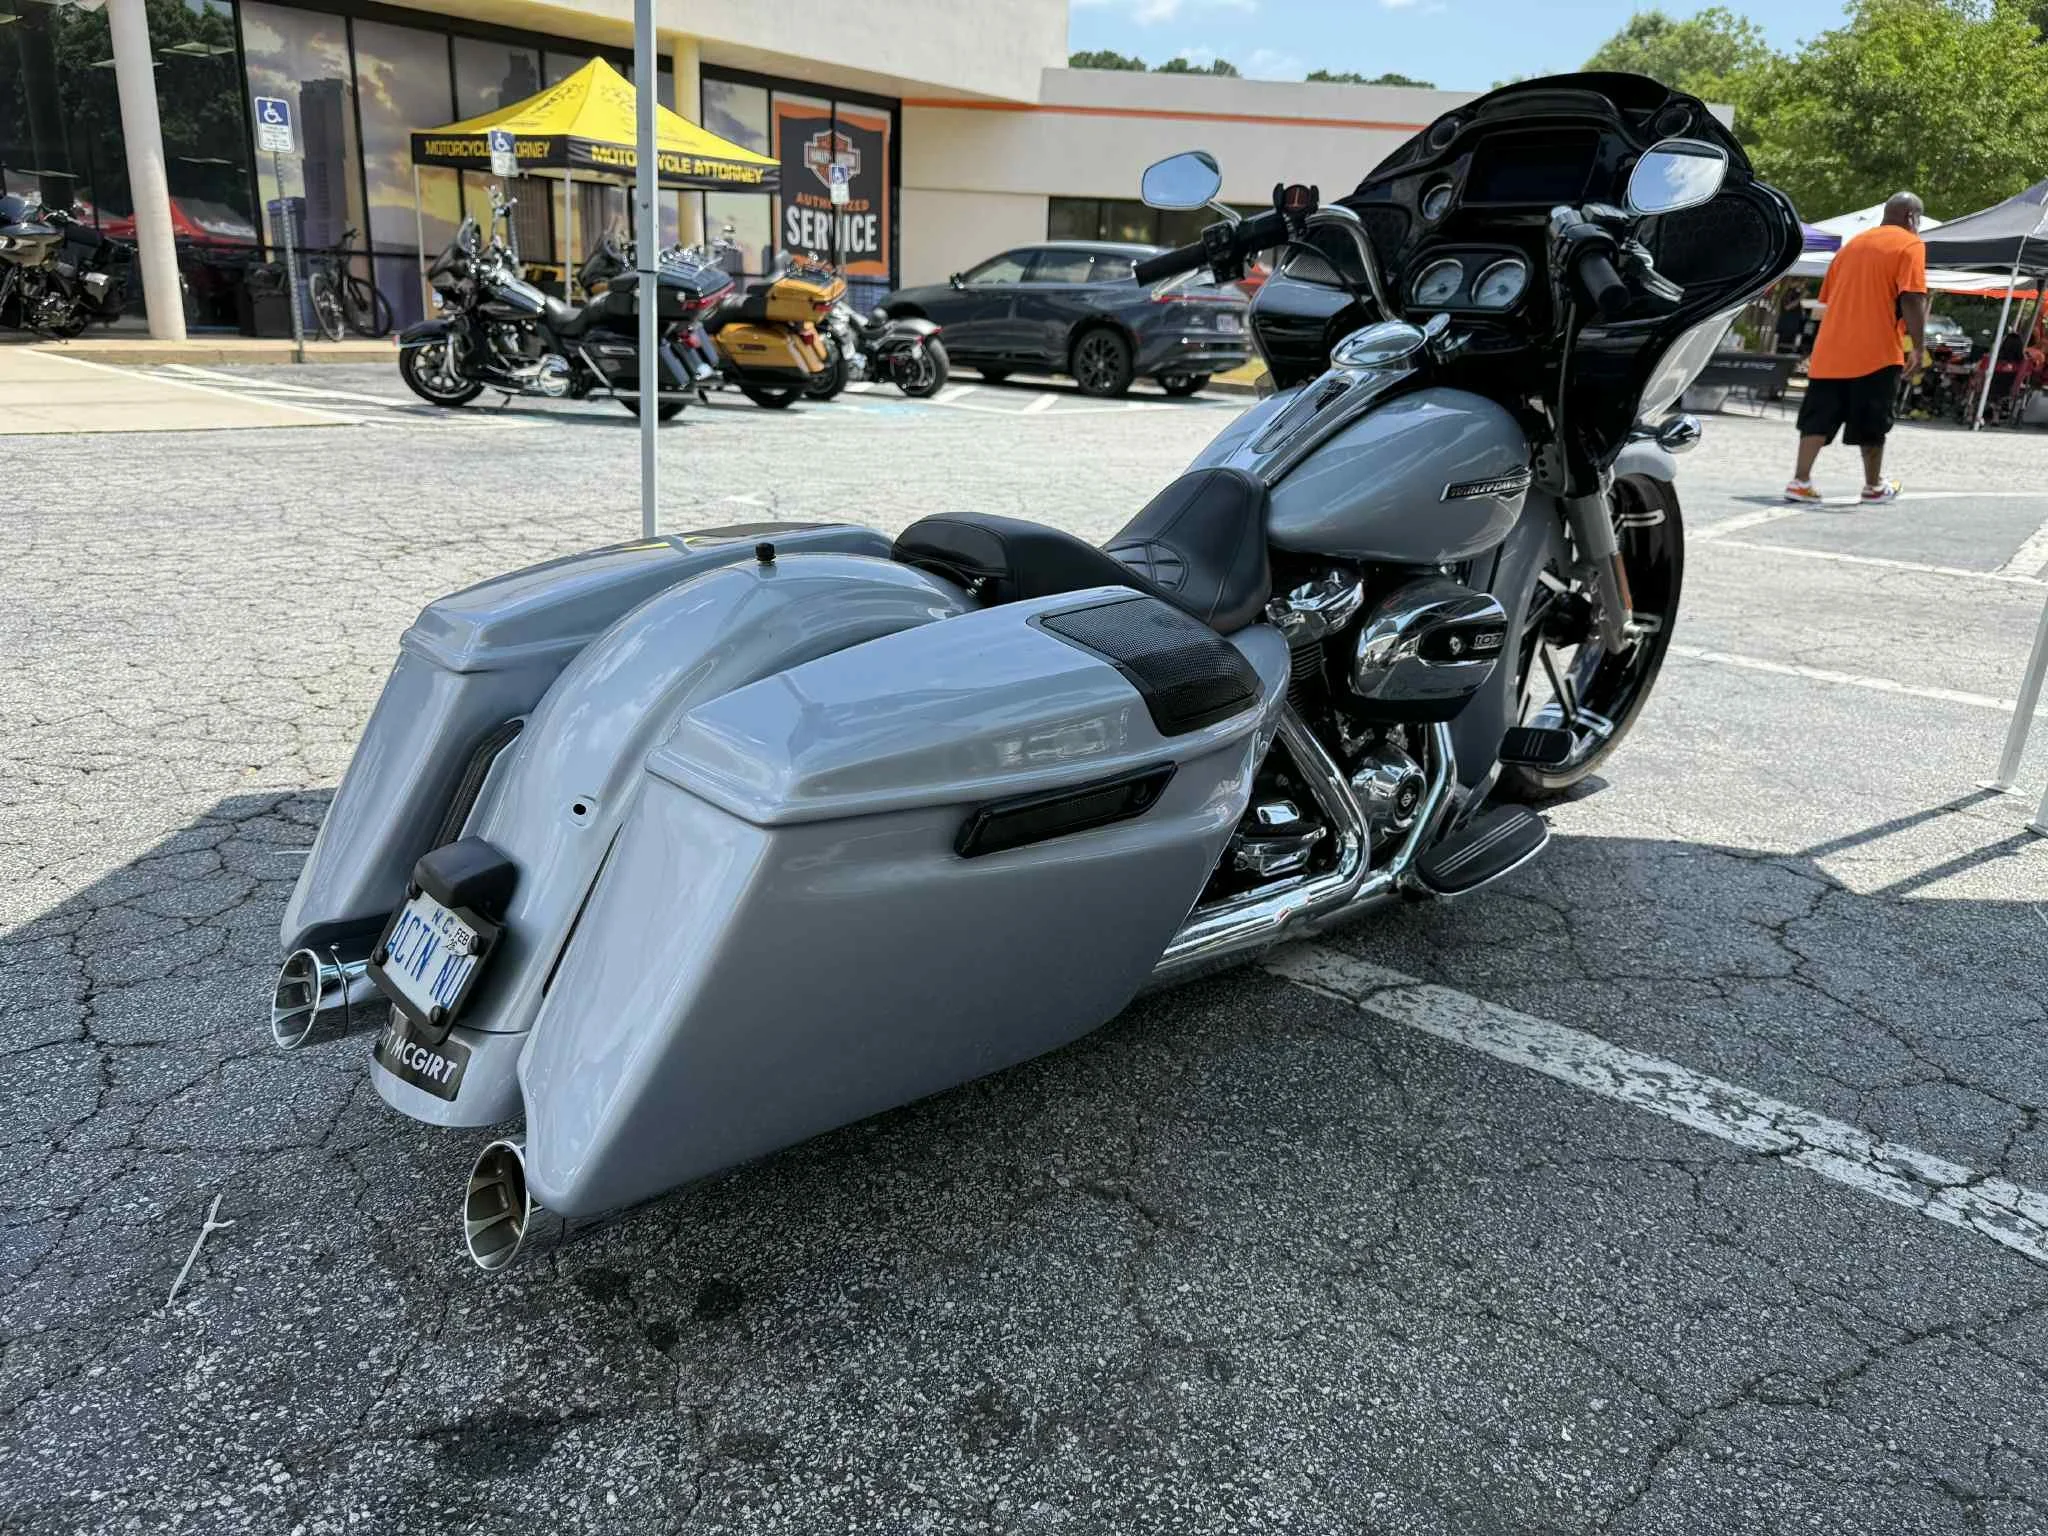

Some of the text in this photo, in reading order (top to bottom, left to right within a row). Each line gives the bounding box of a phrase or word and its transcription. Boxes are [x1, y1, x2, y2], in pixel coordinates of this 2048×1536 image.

[514, 141, 550, 159] ORNEY
[591, 145, 764, 184] MOTOYCLE ATTORNEY
[786, 205, 877, 253] SERVICE
[386, 909, 441, 982] ACTN
[455, 927, 469, 947] FEB
[390, 1035, 458, 1084] MCGIRT
